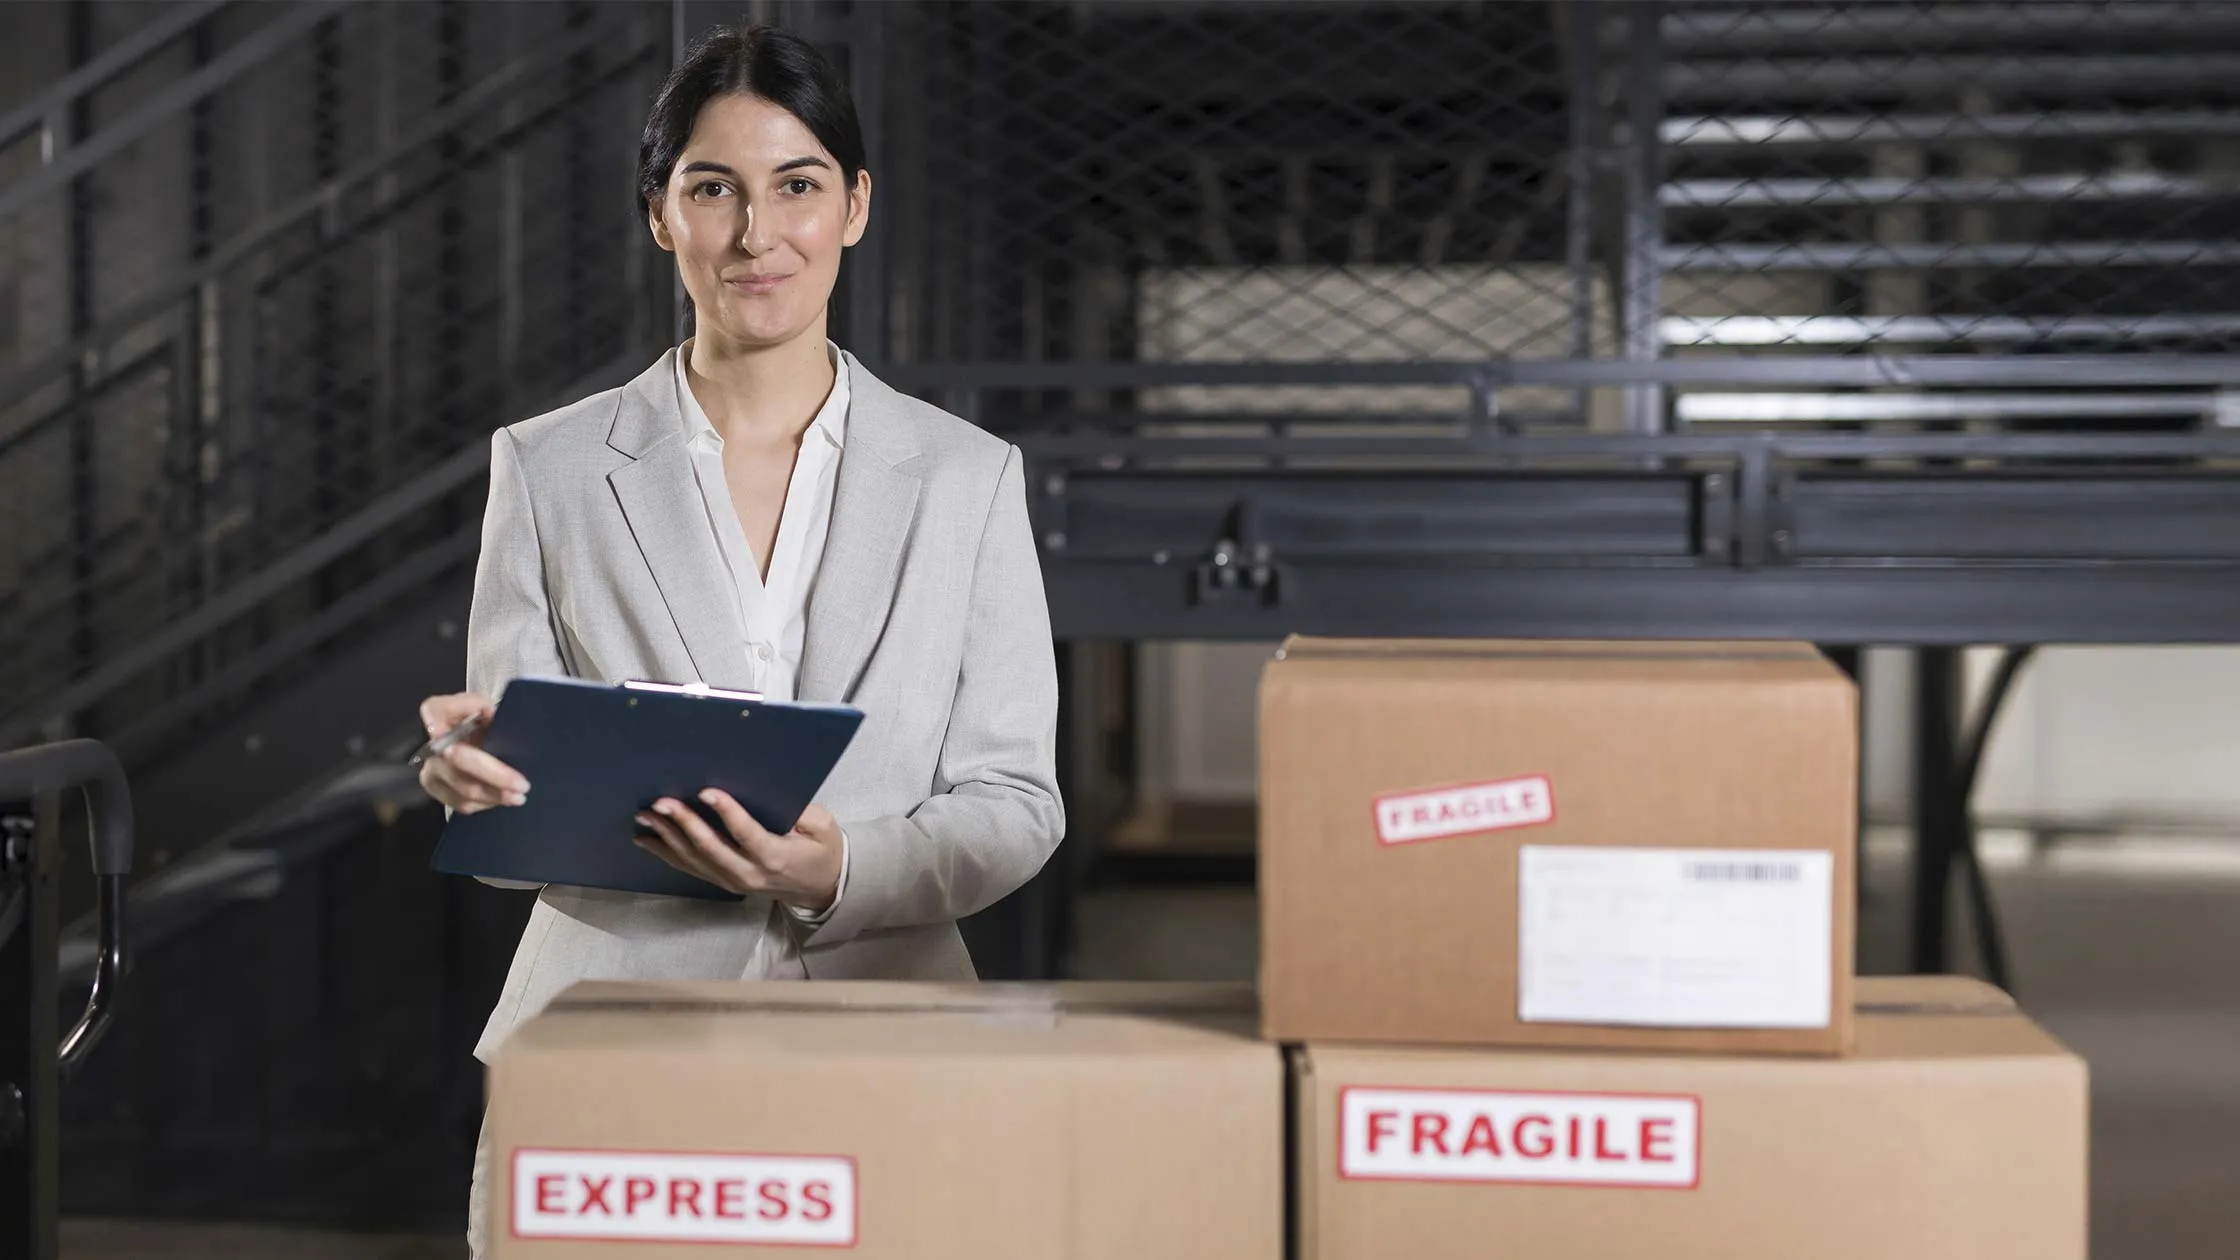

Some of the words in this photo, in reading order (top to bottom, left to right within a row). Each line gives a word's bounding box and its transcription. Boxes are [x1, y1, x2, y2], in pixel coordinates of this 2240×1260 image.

[1390, 791, 1538, 829] FRAGILE
[1366, 1111, 1676, 1162] FRAGILE
[534, 1174, 834, 1222] EXPRESS
